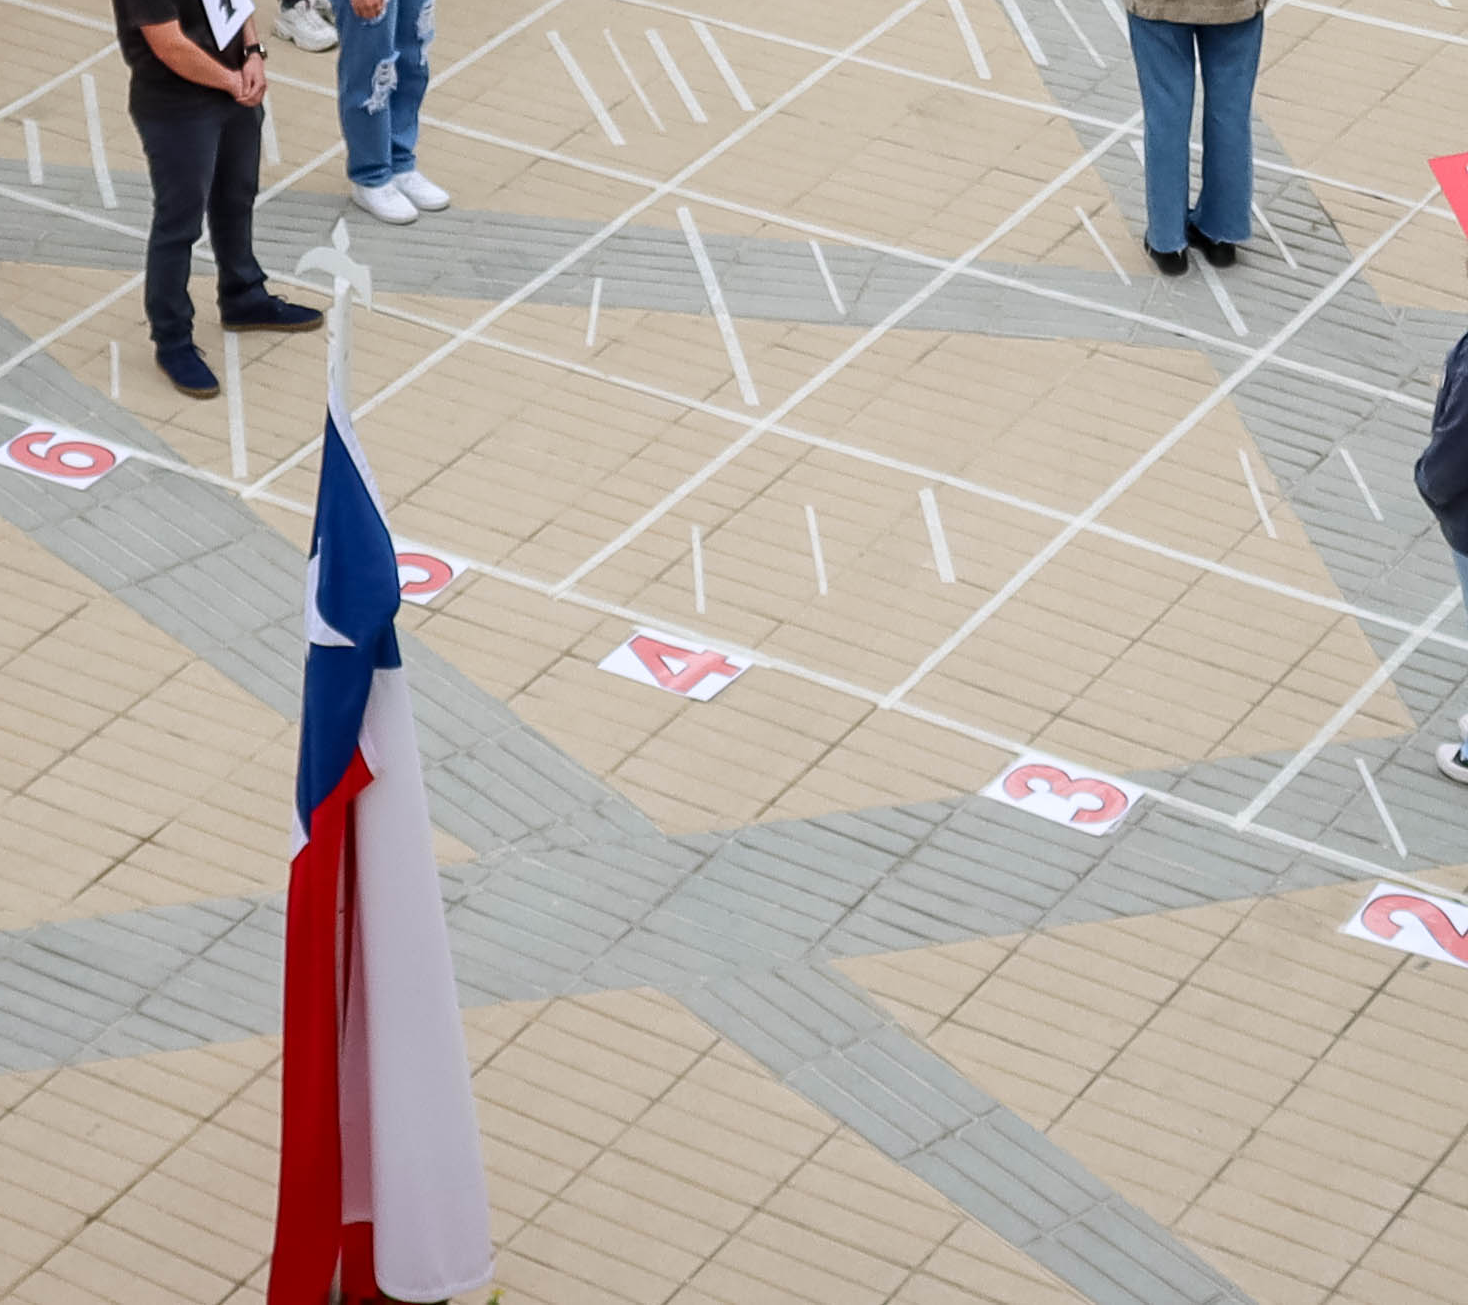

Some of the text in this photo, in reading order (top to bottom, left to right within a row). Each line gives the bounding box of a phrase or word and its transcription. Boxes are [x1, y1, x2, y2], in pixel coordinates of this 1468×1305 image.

[8, 430, 118, 479] 6
[626, 632, 743, 695] 4
[1001, 764, 1130, 826] 3
